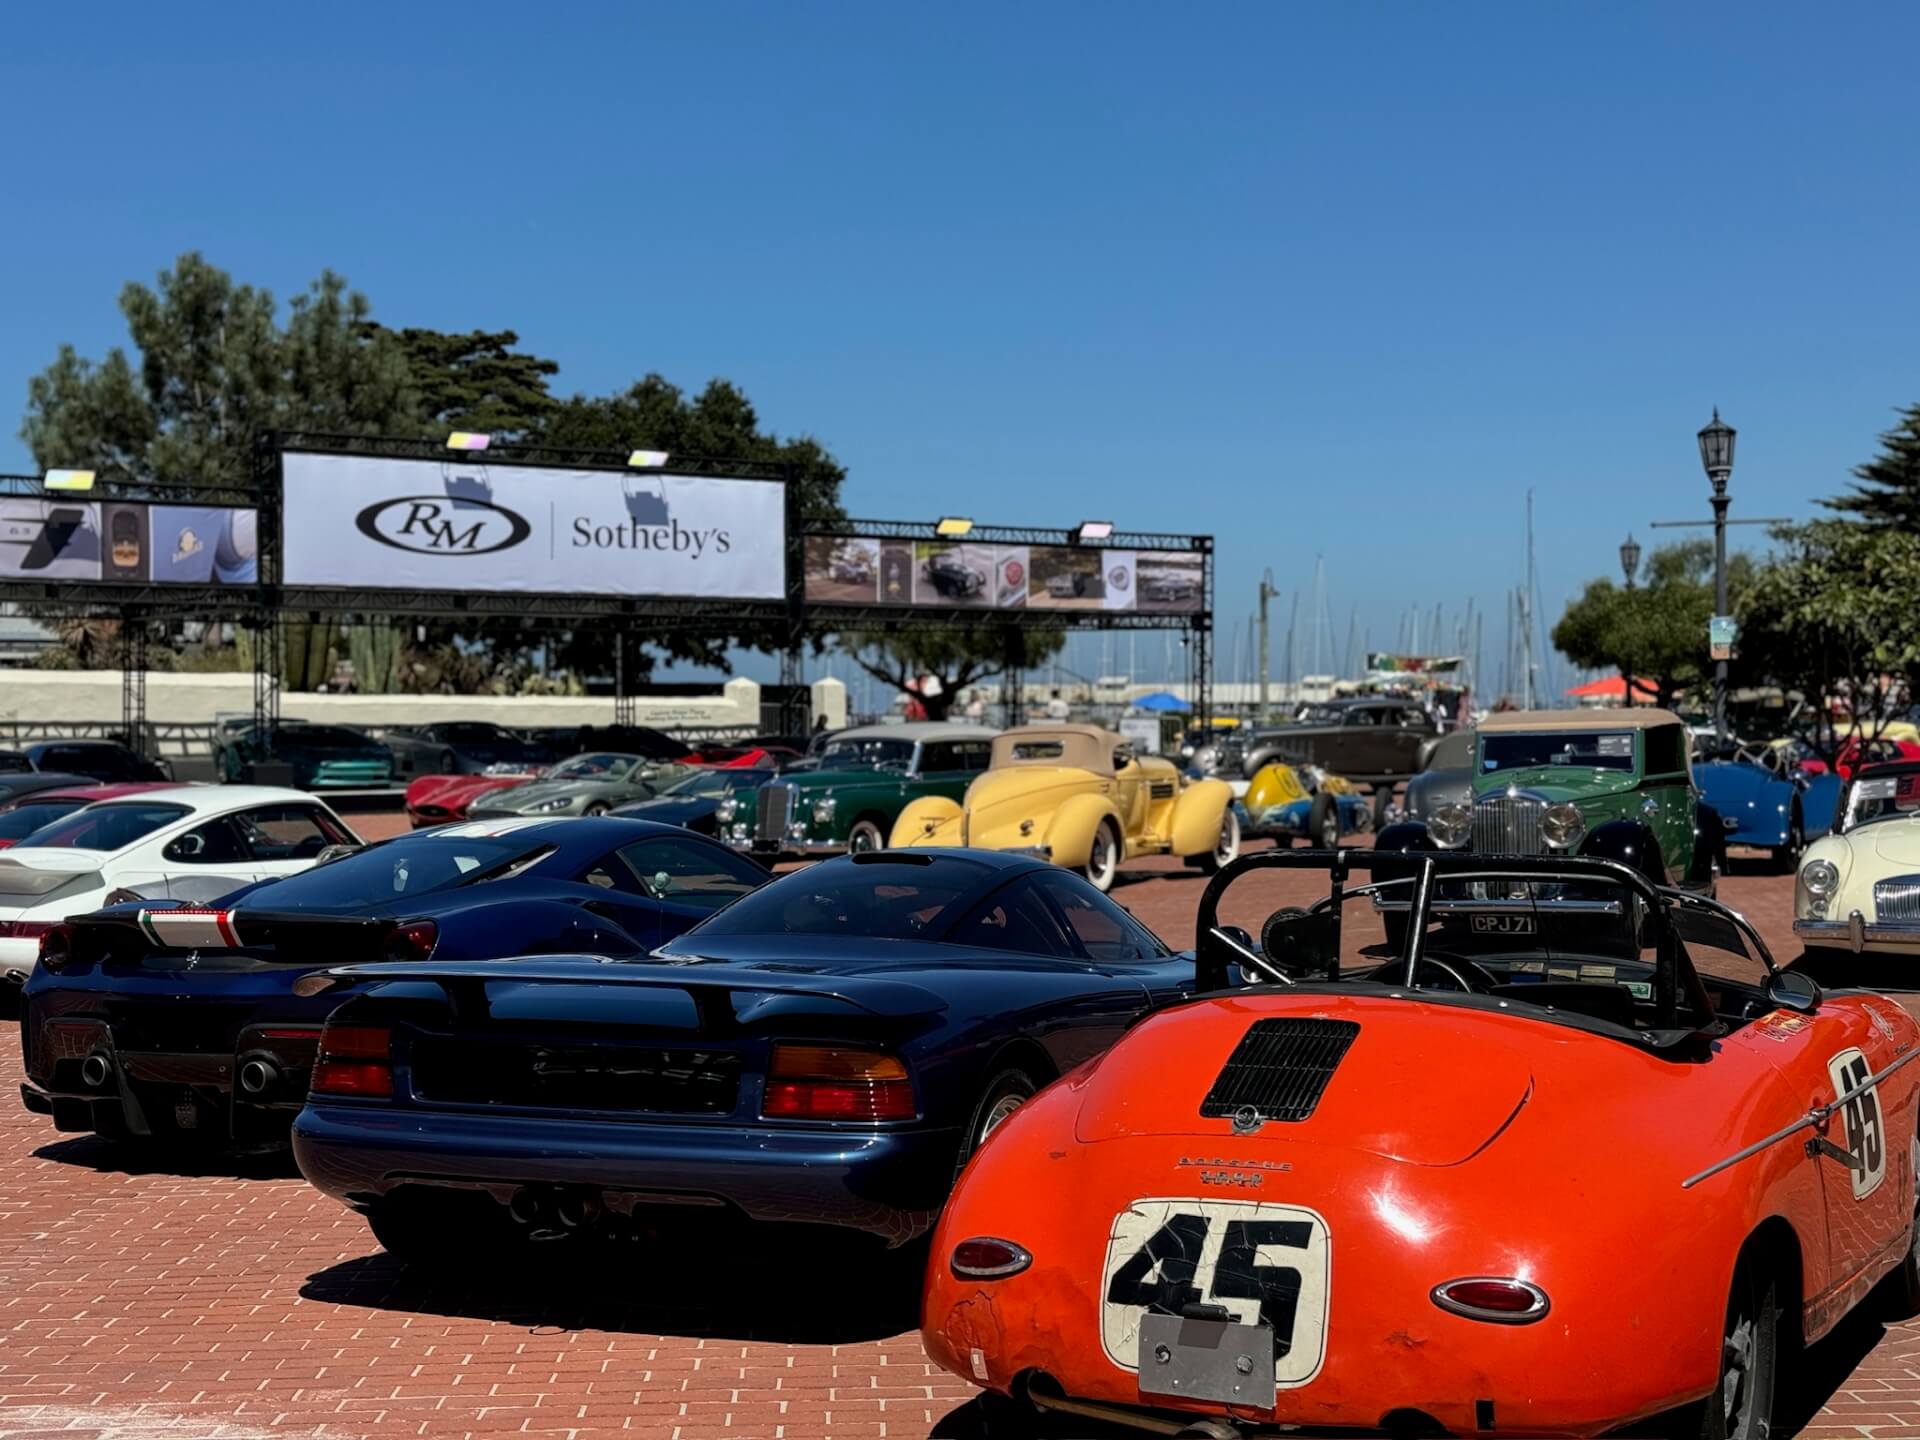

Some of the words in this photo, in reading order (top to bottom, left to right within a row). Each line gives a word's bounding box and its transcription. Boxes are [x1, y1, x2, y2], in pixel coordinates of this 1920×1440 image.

[397, 502, 487, 549] RM
[572, 516, 731, 560] Sotheby's
[1840, 1055, 1881, 1185] 45
[1107, 1213, 1314, 1362] 45
